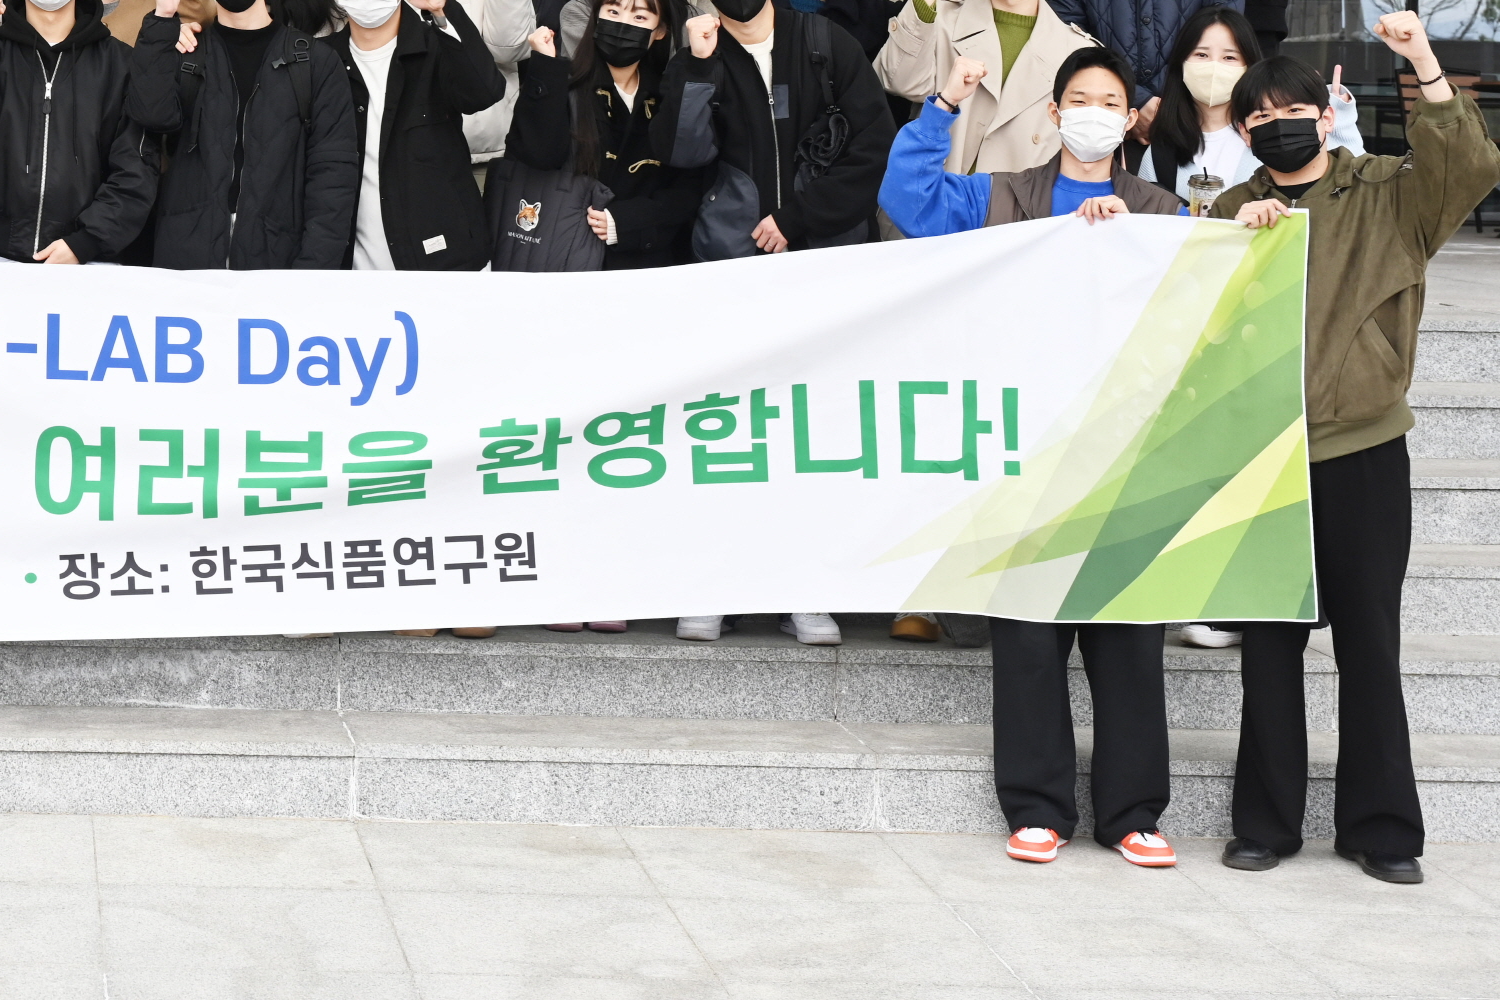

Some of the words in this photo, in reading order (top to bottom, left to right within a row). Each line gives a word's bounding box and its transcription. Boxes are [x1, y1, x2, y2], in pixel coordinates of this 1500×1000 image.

[237, 311, 419, 406] Day)
[35, 426, 433, 521] 여러분을
[476, 380, 1021, 495] 환영합니다!
[59, 551, 170, 600] 장소:
[189, 531, 538, 595] 한국식품연구원
